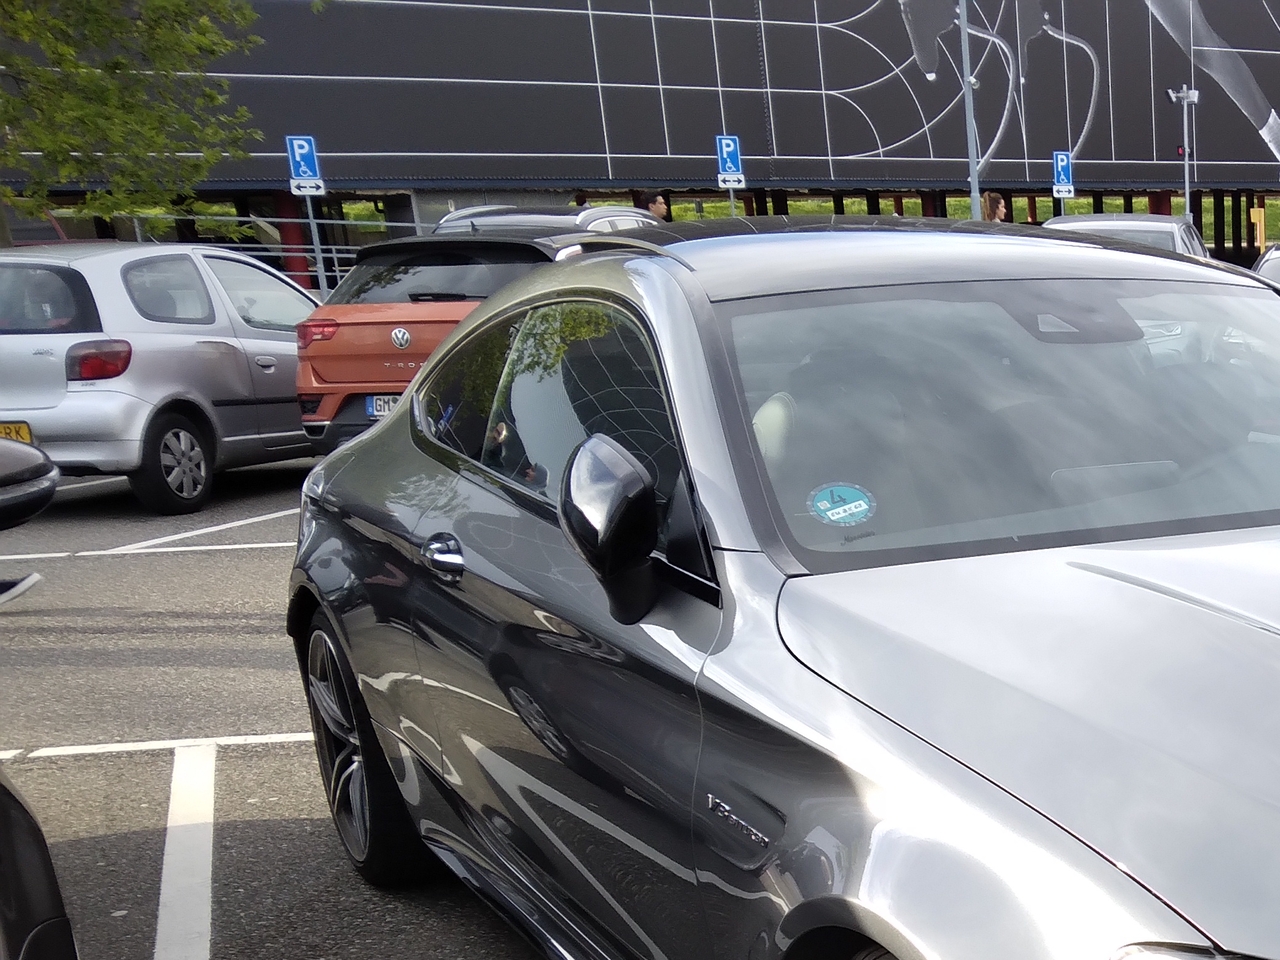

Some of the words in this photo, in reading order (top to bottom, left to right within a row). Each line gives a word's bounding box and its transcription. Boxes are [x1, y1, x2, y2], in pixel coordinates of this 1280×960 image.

[292, 139, 309, 161] P
[721, 139, 735, 158] P
[1057, 154, 1068, 171] P
[829, 489, 848, 505] 4
